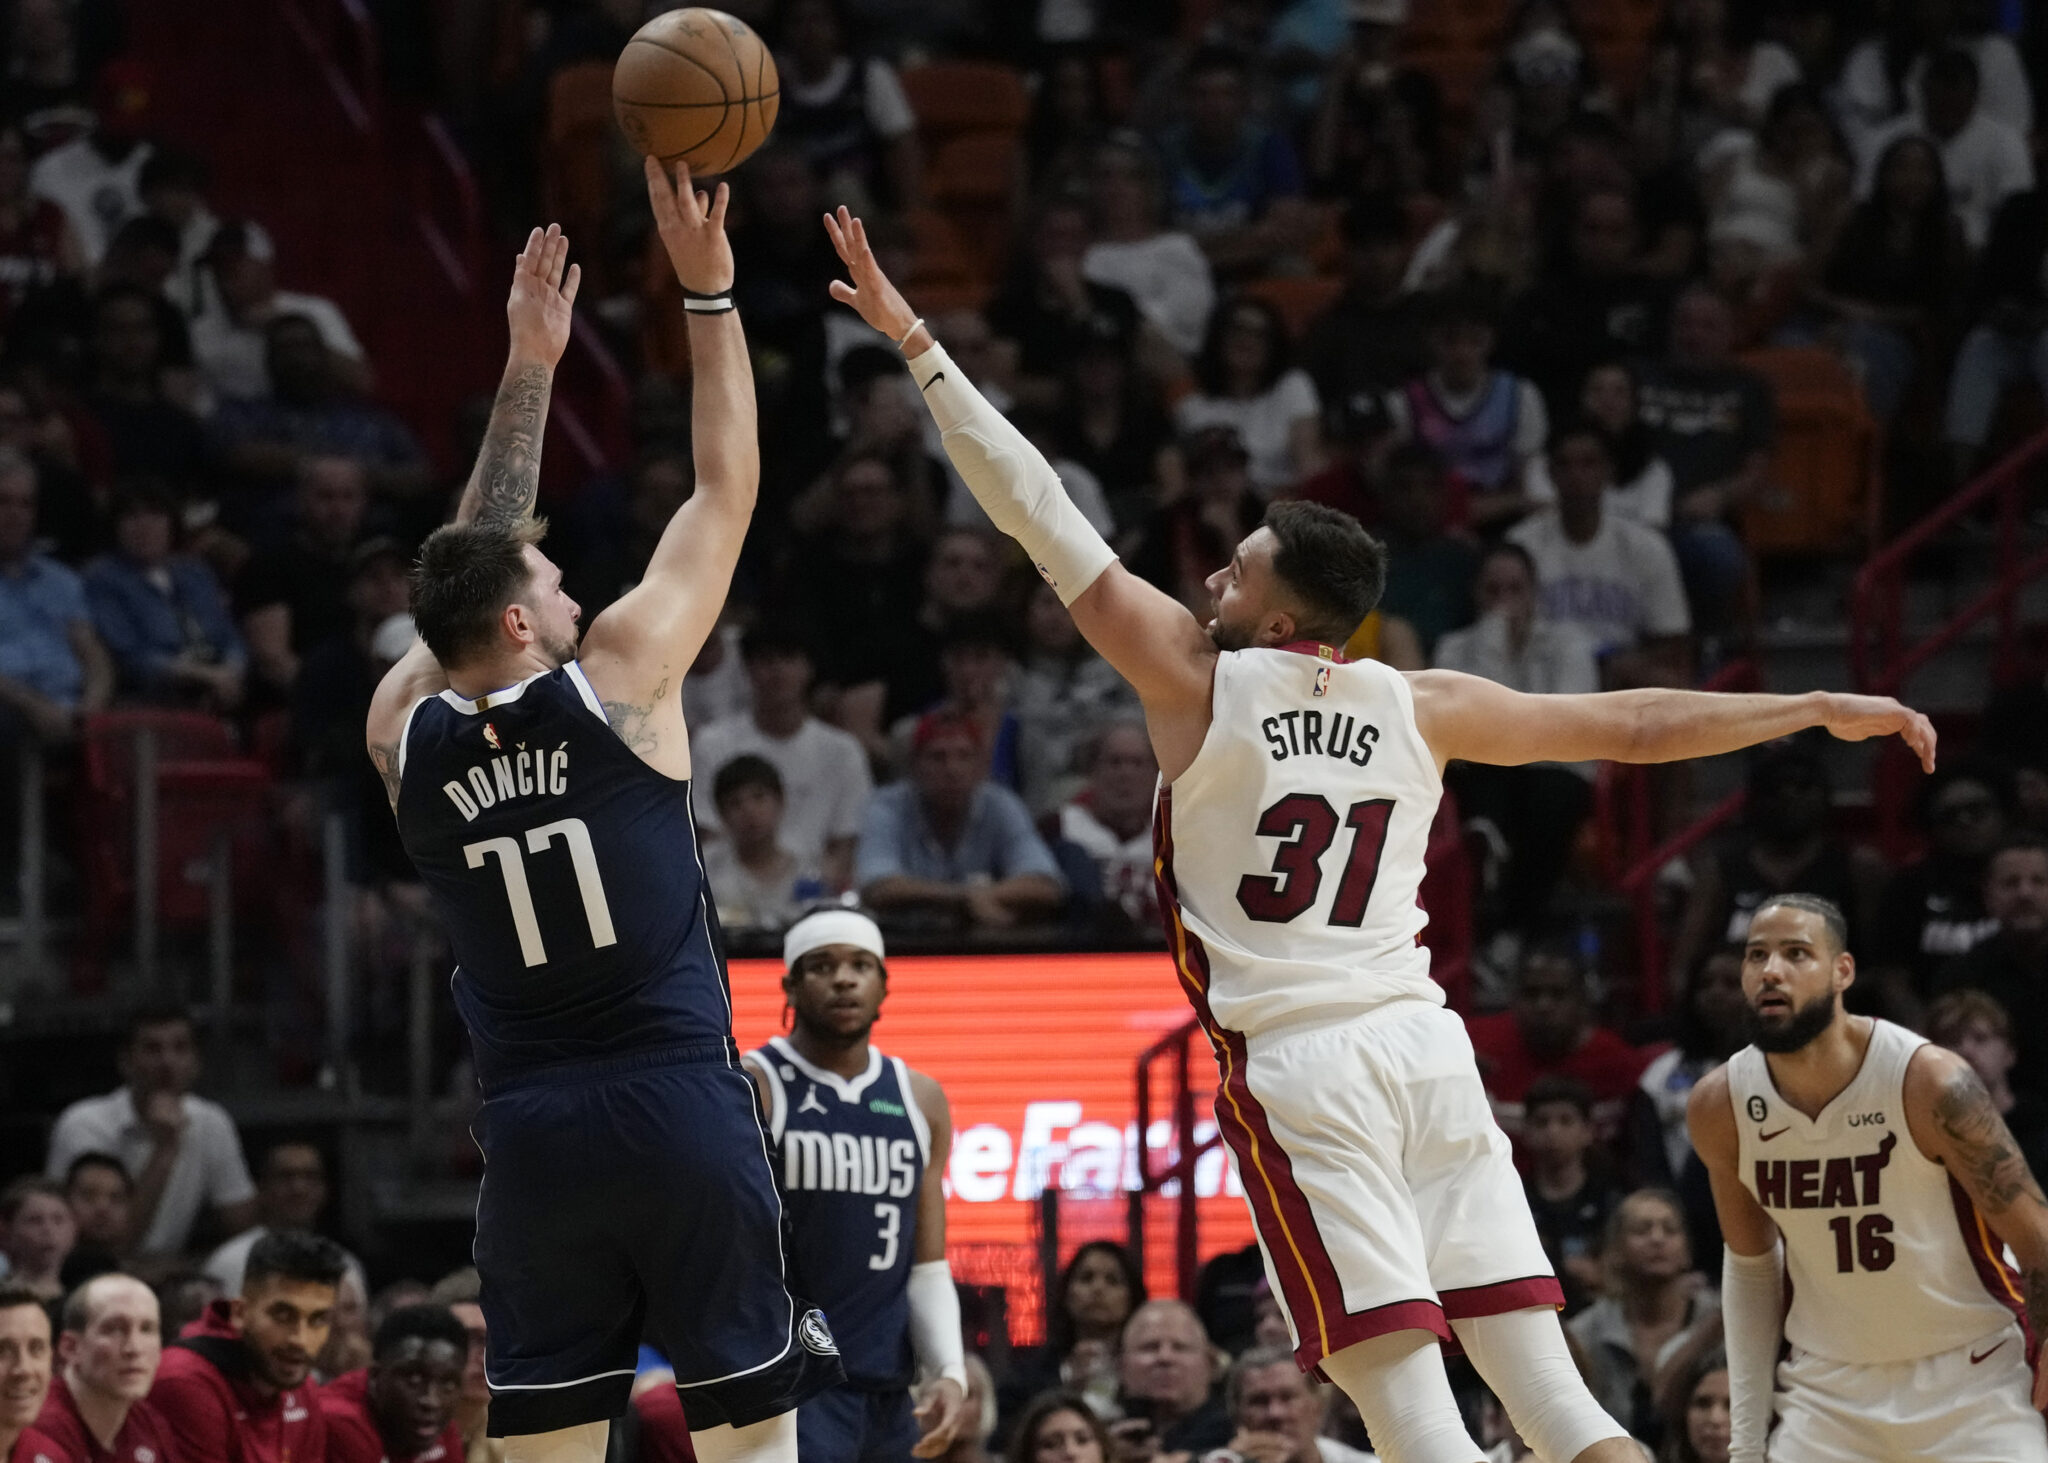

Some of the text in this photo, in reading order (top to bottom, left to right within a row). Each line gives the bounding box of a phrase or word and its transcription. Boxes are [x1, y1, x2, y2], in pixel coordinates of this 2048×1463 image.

[1261, 710, 1380, 767] STRUS
[442, 741, 569, 823] DONČIĆ
[462, 817, 618, 968] 77
[1235, 792, 1397, 928] 31
[1748, 1098, 1766, 1121] 6
[1848, 1111, 1886, 1127] UKG
[785, 1130, 915, 1198] MAVS
[1755, 1130, 1897, 1209] HEAT
[868, 1202, 901, 1270] 3
[1828, 1213, 1895, 1274] 16
